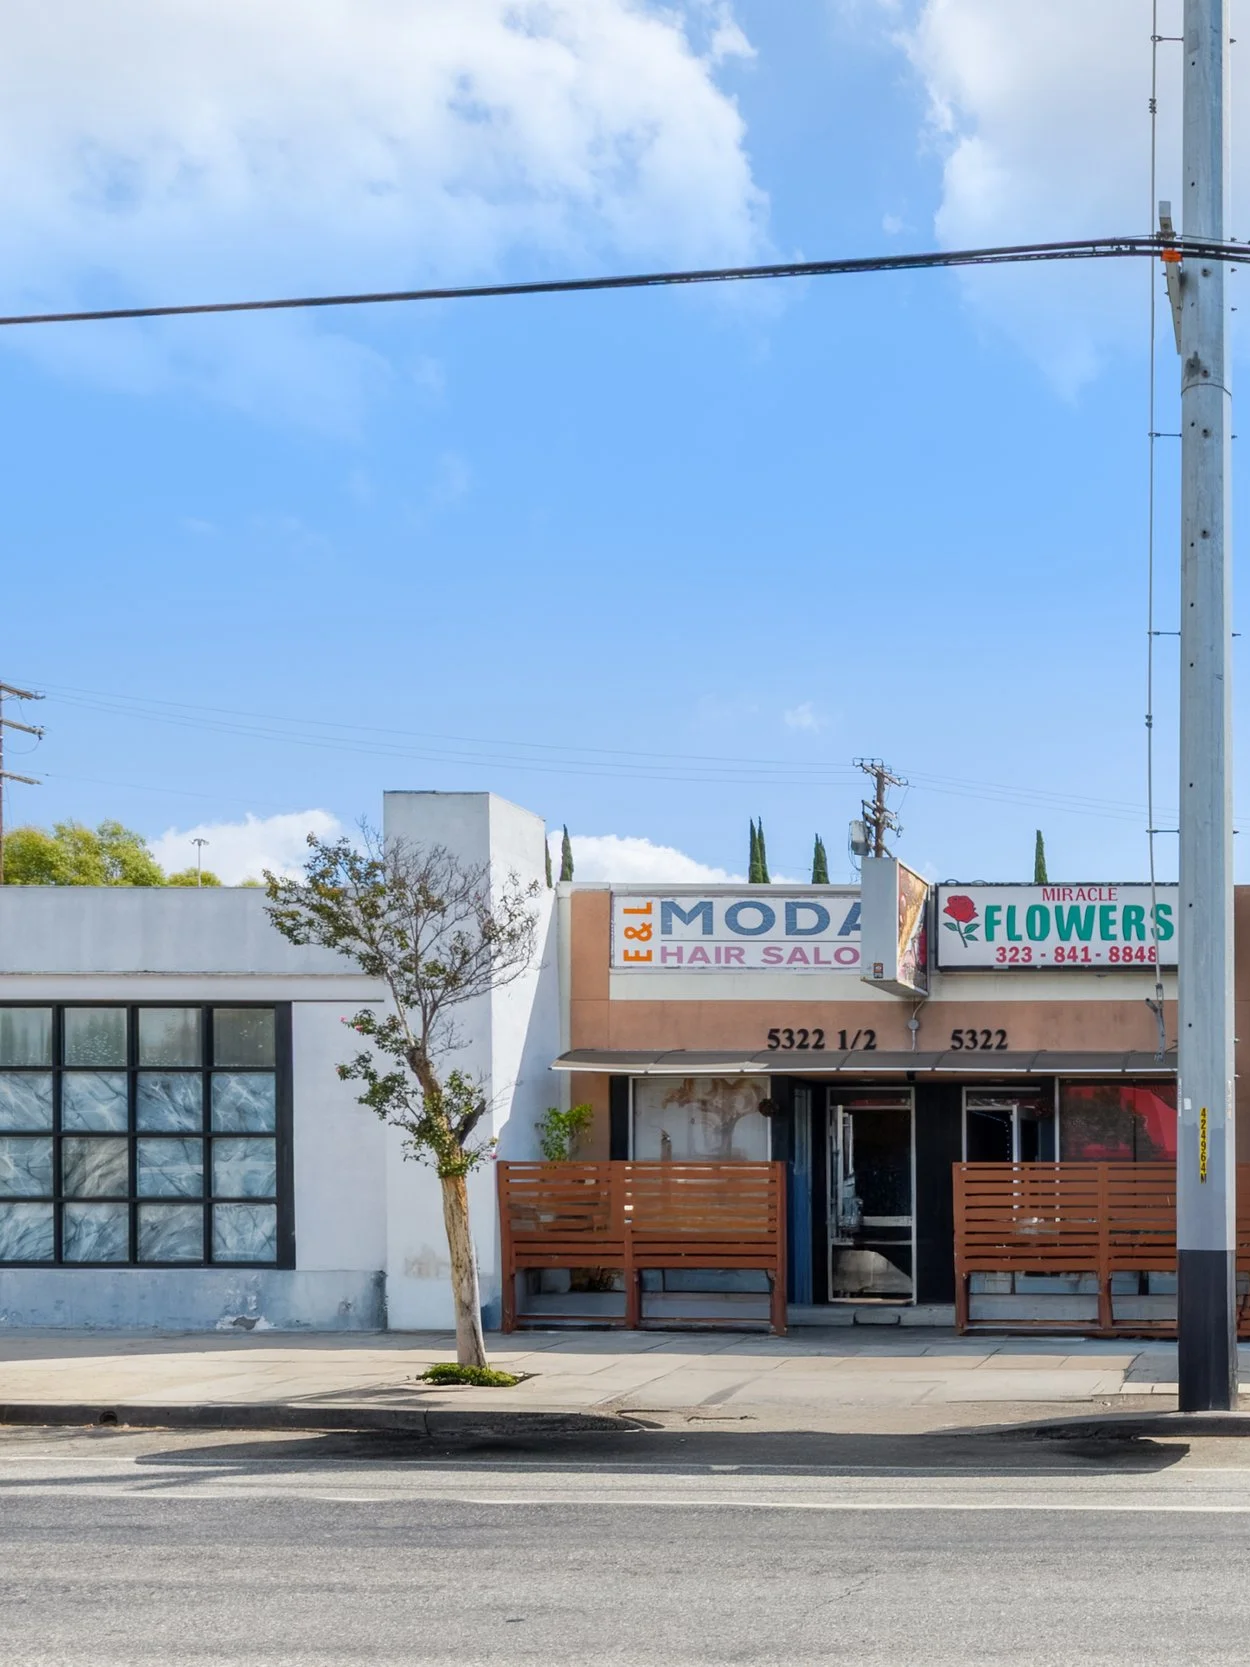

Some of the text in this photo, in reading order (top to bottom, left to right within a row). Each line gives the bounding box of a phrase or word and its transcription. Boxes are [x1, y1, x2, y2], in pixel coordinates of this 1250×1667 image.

[1042, 887, 1118, 902] MIRACLE
[623, 902, 653, 962] E & L
[984, 904, 1175, 942] FLOWERS
[660, 946, 861, 965] HAIR SALO
[995, 946, 1033, 963] 323
[1108, 945, 1157, 963] 8848
[767, 1028, 878, 1050] 5322 1/2
[950, 1029, 1009, 1050] 5322
